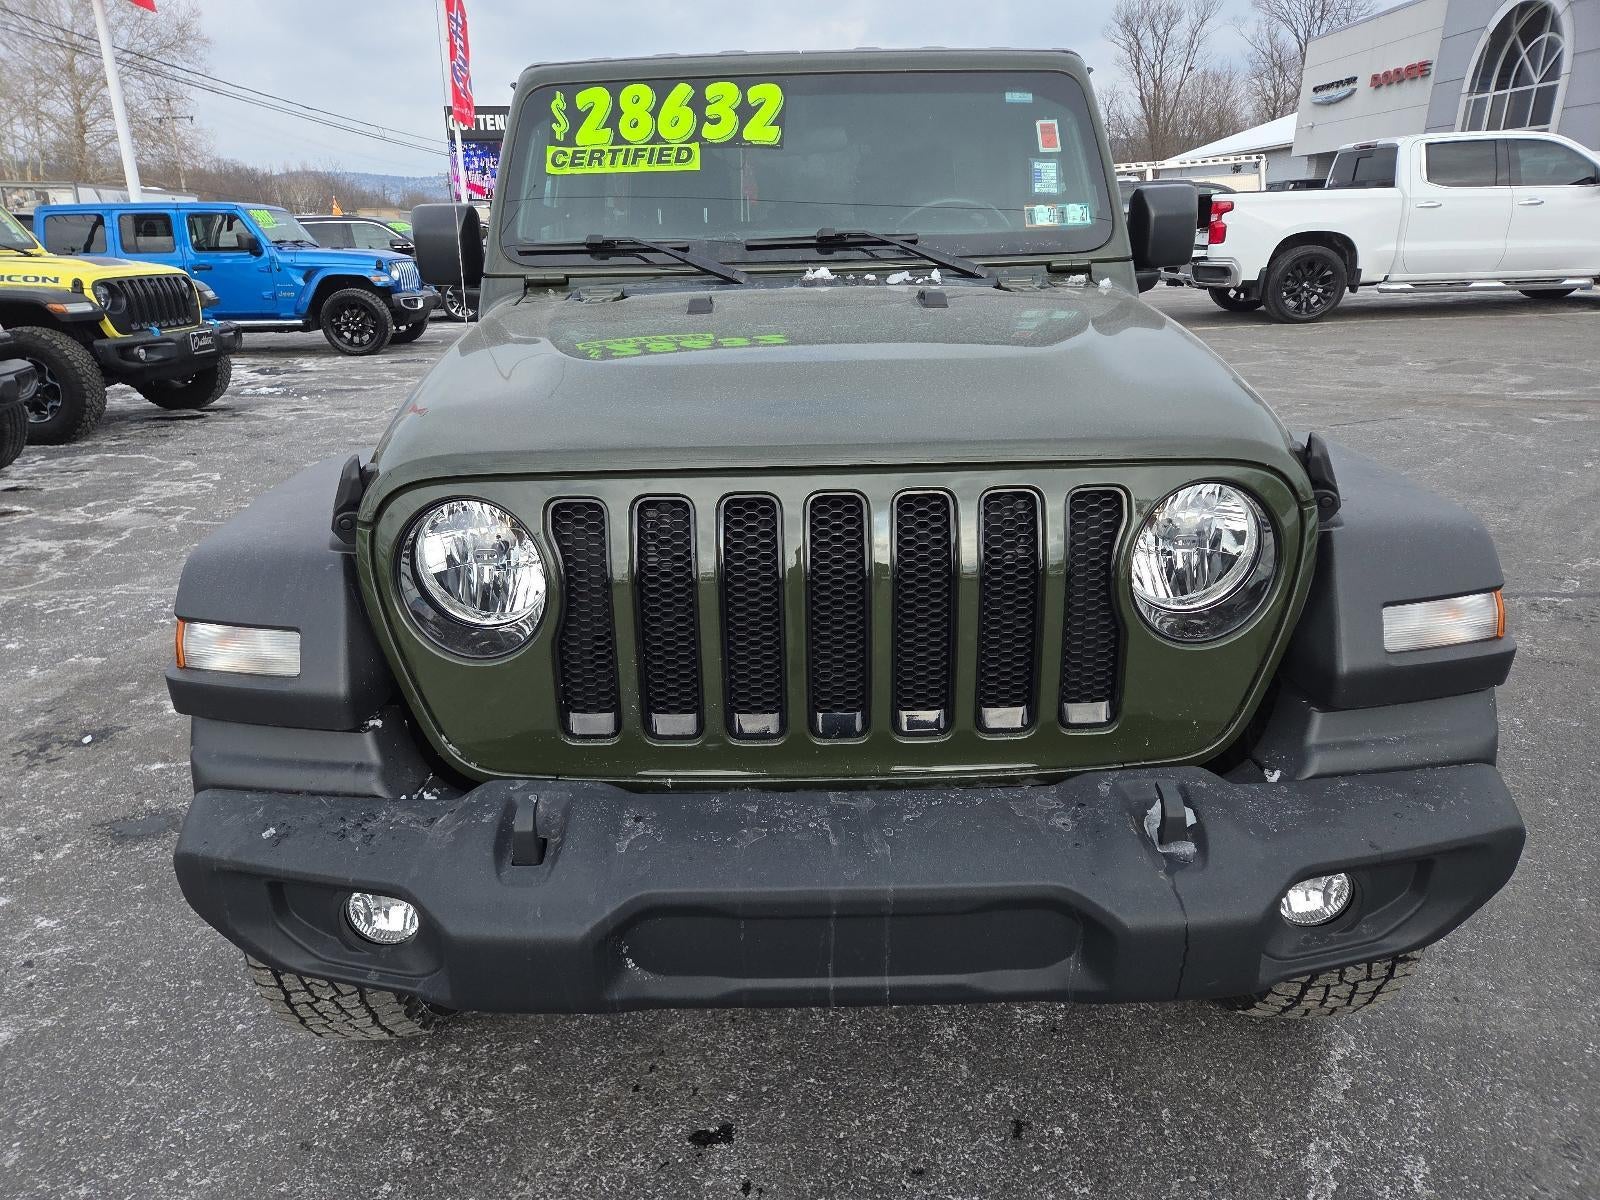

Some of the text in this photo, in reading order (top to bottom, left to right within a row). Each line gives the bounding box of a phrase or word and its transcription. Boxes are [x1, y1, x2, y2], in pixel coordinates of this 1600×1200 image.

[1370, 60, 1433, 88] DODGE
[551, 82, 784, 147] $28632
[550, 146, 695, 170] CERTIFIED
